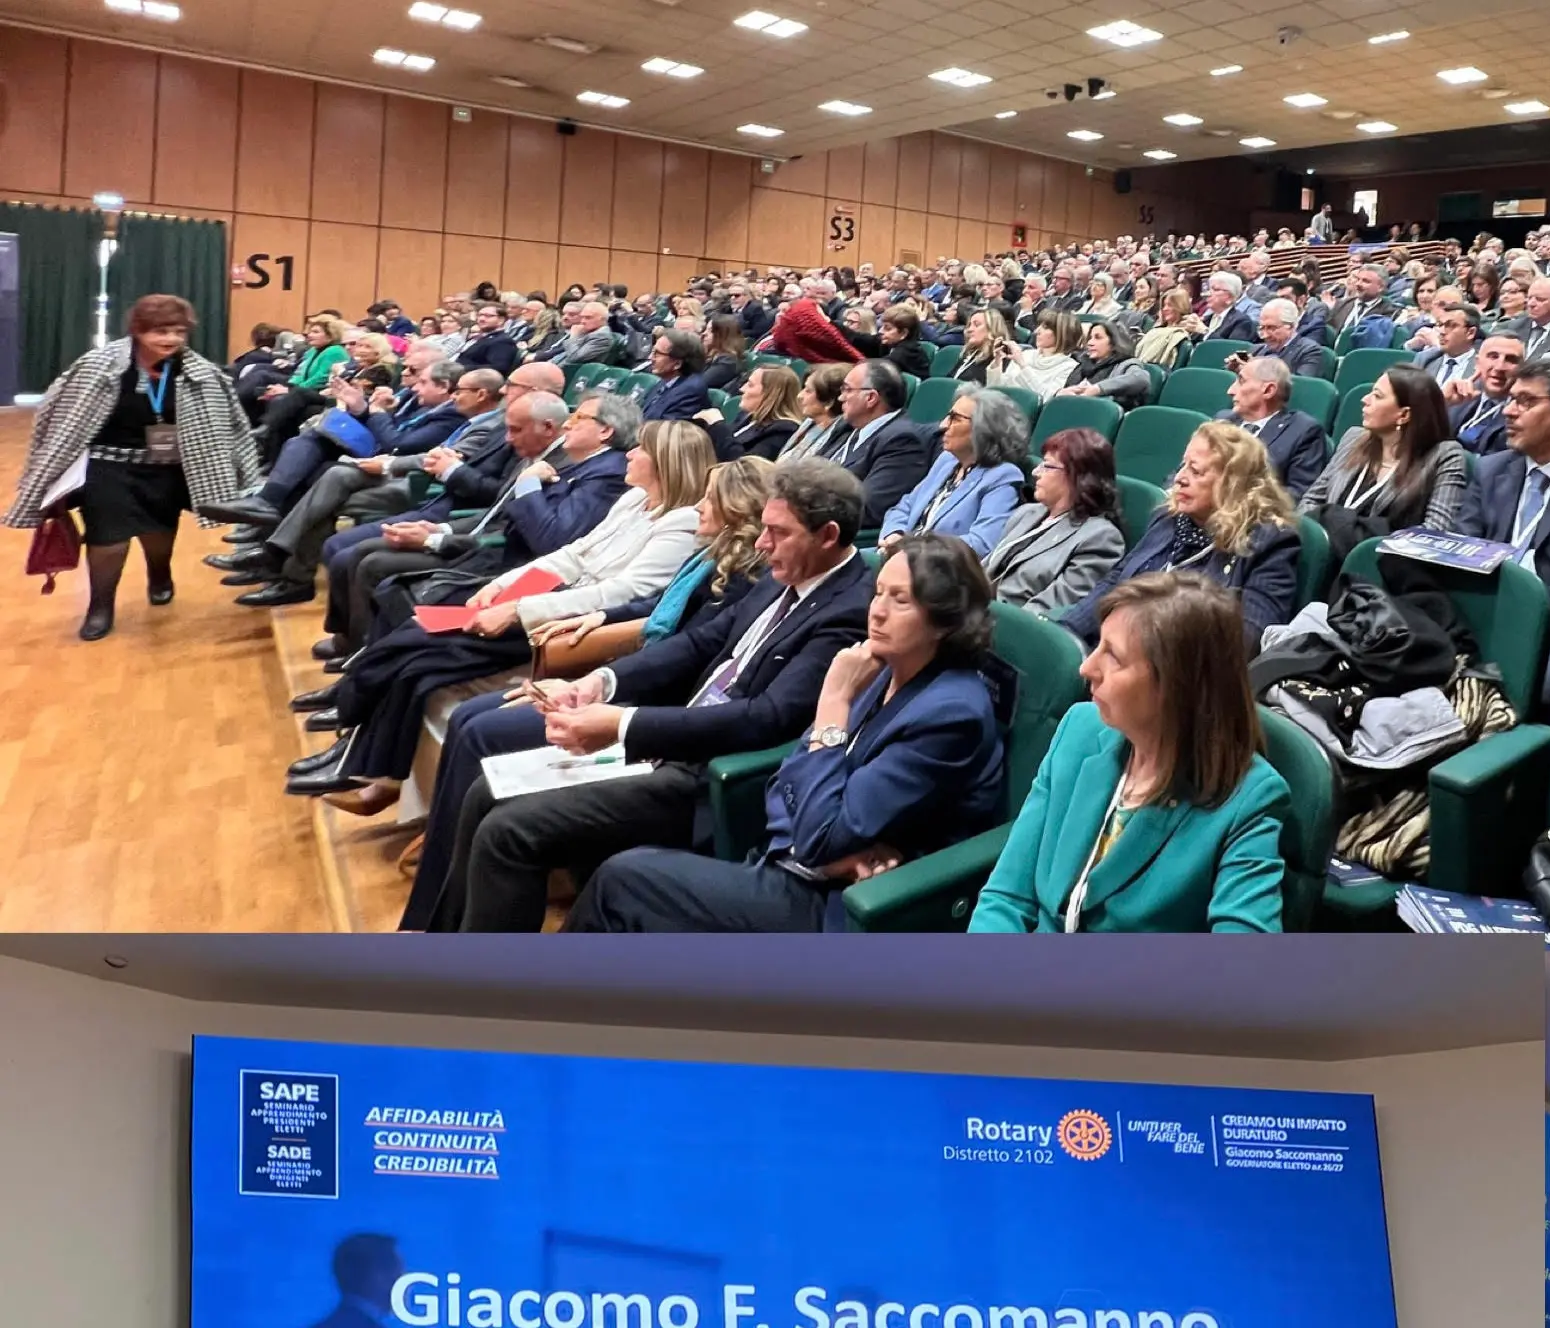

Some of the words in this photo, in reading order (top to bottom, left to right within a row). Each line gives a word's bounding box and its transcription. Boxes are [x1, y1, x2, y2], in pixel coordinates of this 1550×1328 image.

[830, 216, 854, 242] S3
[245, 253, 294, 291] S1
[260, 1081, 320, 1103] SAPE
[251, 1108, 327, 1120] APPRENDIMENTO
[264, 1102, 315, 1112] SEMINARIO
[263, 1117, 315, 1127] PRESIDENTI
[365, 1106, 505, 1128] AFFIDABILITÀ
[1222, 1114, 1276, 1128] CREIAMO
[1277, 1116, 1295, 1129] UN
[1296, 1118, 1347, 1131] IMPATTO
[274, 1125, 304, 1134] ELETTI
[966, 1117, 1053, 1147] Rotary
[1127, 1120, 1159, 1132] UNITI
[1160, 1121, 1182, 1133] PER
[1223, 1128, 1288, 1141] DURATURO
[374, 1130, 498, 1152] CONTINUITÀ
[1147, 1131, 1177, 1143] FARE
[1177, 1132, 1200, 1144] DEL
[267, 1145, 312, 1161] SADE
[943, 1145, 1010, 1163] Distretto
[1014, 1148, 1054, 1165] 2102
[1174, 1142, 1205, 1154] BENE
[1225, 1146, 1274, 1159] Giacomo
[1275, 1148, 1344, 1162] Saccomanno
[256, 1166, 322, 1177] APPRENDIMENTO
[267, 1161, 311, 1170] SEMINARIO
[374, 1154, 499, 1176] CREDIBILITÀ
[1226, 1159, 1282, 1169] GOVERNATORE
[1283, 1161, 1311, 1171] ELETTO
[390, 1272, 700, 1328] Giacomo
